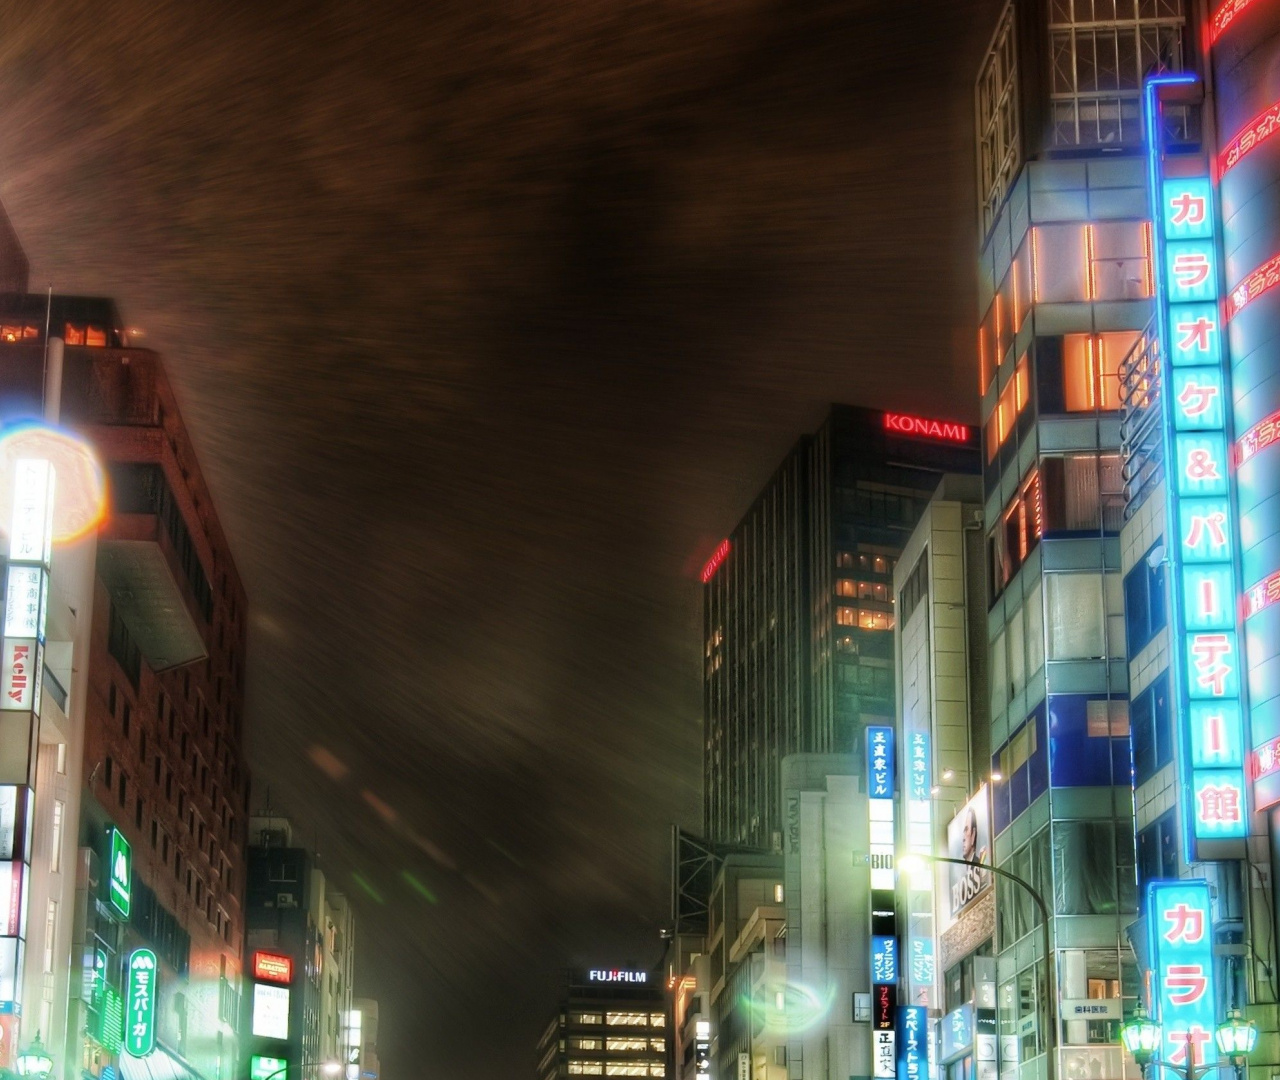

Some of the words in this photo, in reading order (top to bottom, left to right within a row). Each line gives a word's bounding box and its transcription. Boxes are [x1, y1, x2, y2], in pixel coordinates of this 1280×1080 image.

[885, 413, 967, 442] KONAMI
[7, 645, 30, 704] Kelly
[951, 865, 982, 914] BOSS
[589, 969, 647, 983] FUJIFILM
[131, 970, 150, 1050] モスバーガー
[1073, 1005, 1109, 1015] 歯科医院
